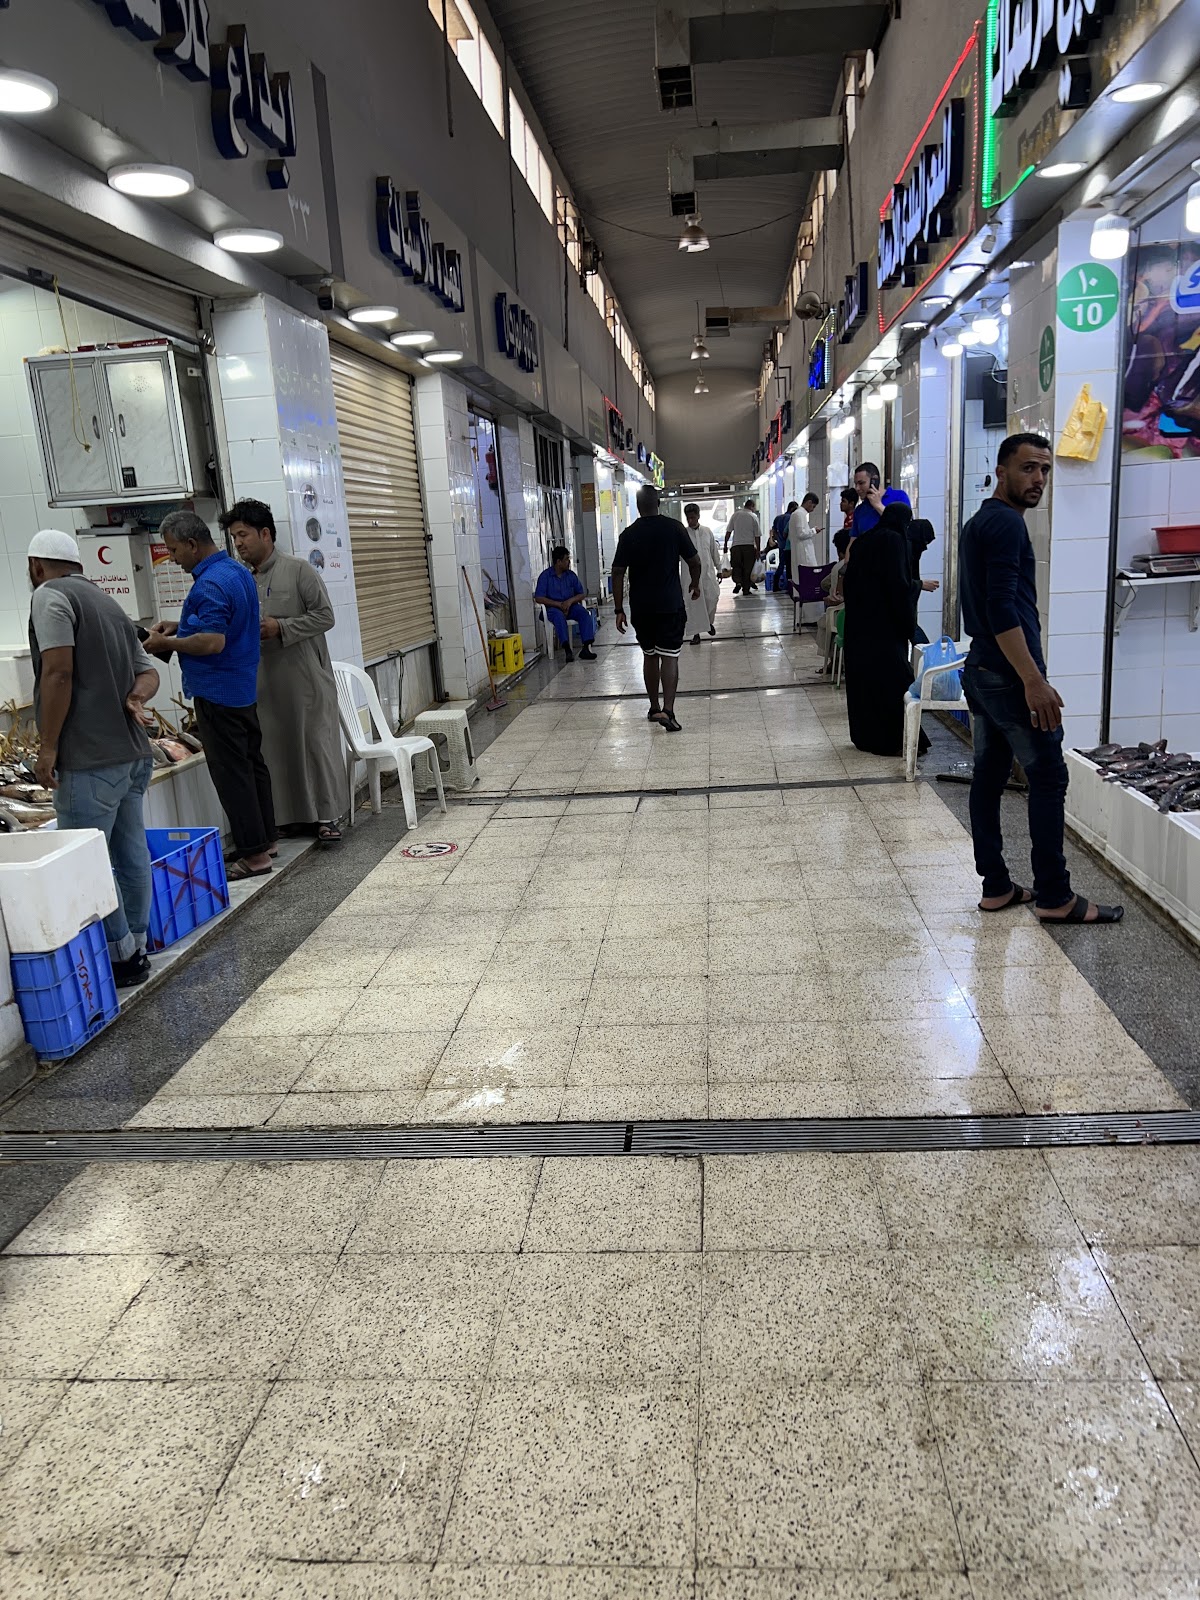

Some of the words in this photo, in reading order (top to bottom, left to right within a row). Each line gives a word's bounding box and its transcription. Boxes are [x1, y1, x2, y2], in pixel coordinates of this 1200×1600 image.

[1078, 268, 1099, 294] ١٠
[1072, 302, 1103, 326] 10
[1042, 363, 1052, 386] 10
